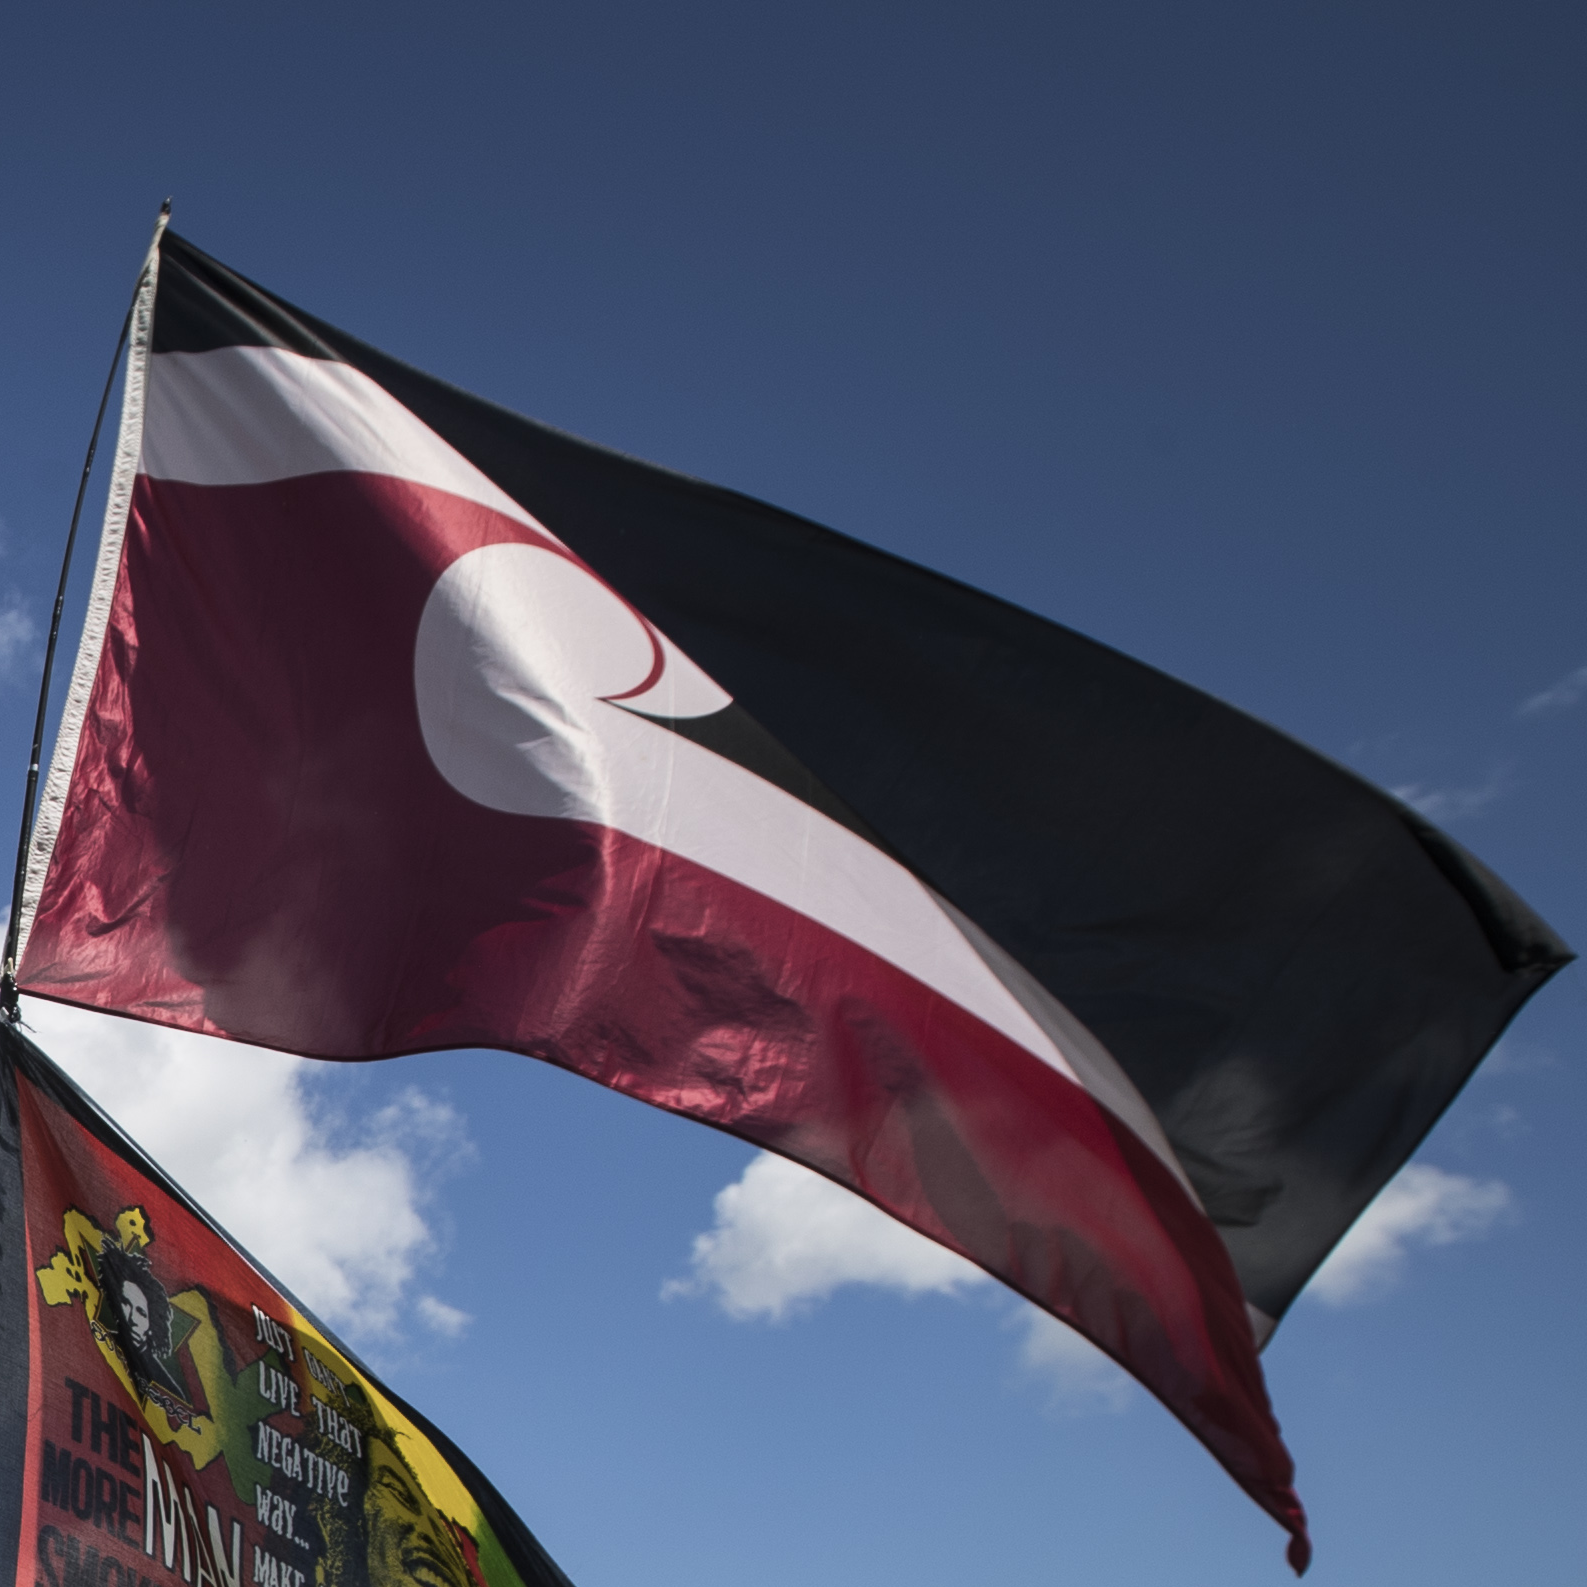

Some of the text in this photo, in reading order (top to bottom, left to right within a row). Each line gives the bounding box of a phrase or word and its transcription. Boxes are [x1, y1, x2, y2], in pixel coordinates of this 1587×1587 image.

[251, 1304, 295, 1361] JUST
[64, 1377, 141, 1478] THE
[258, 1360, 301, 1417] LIVE
[41, 1440, 143, 1552] MORE
